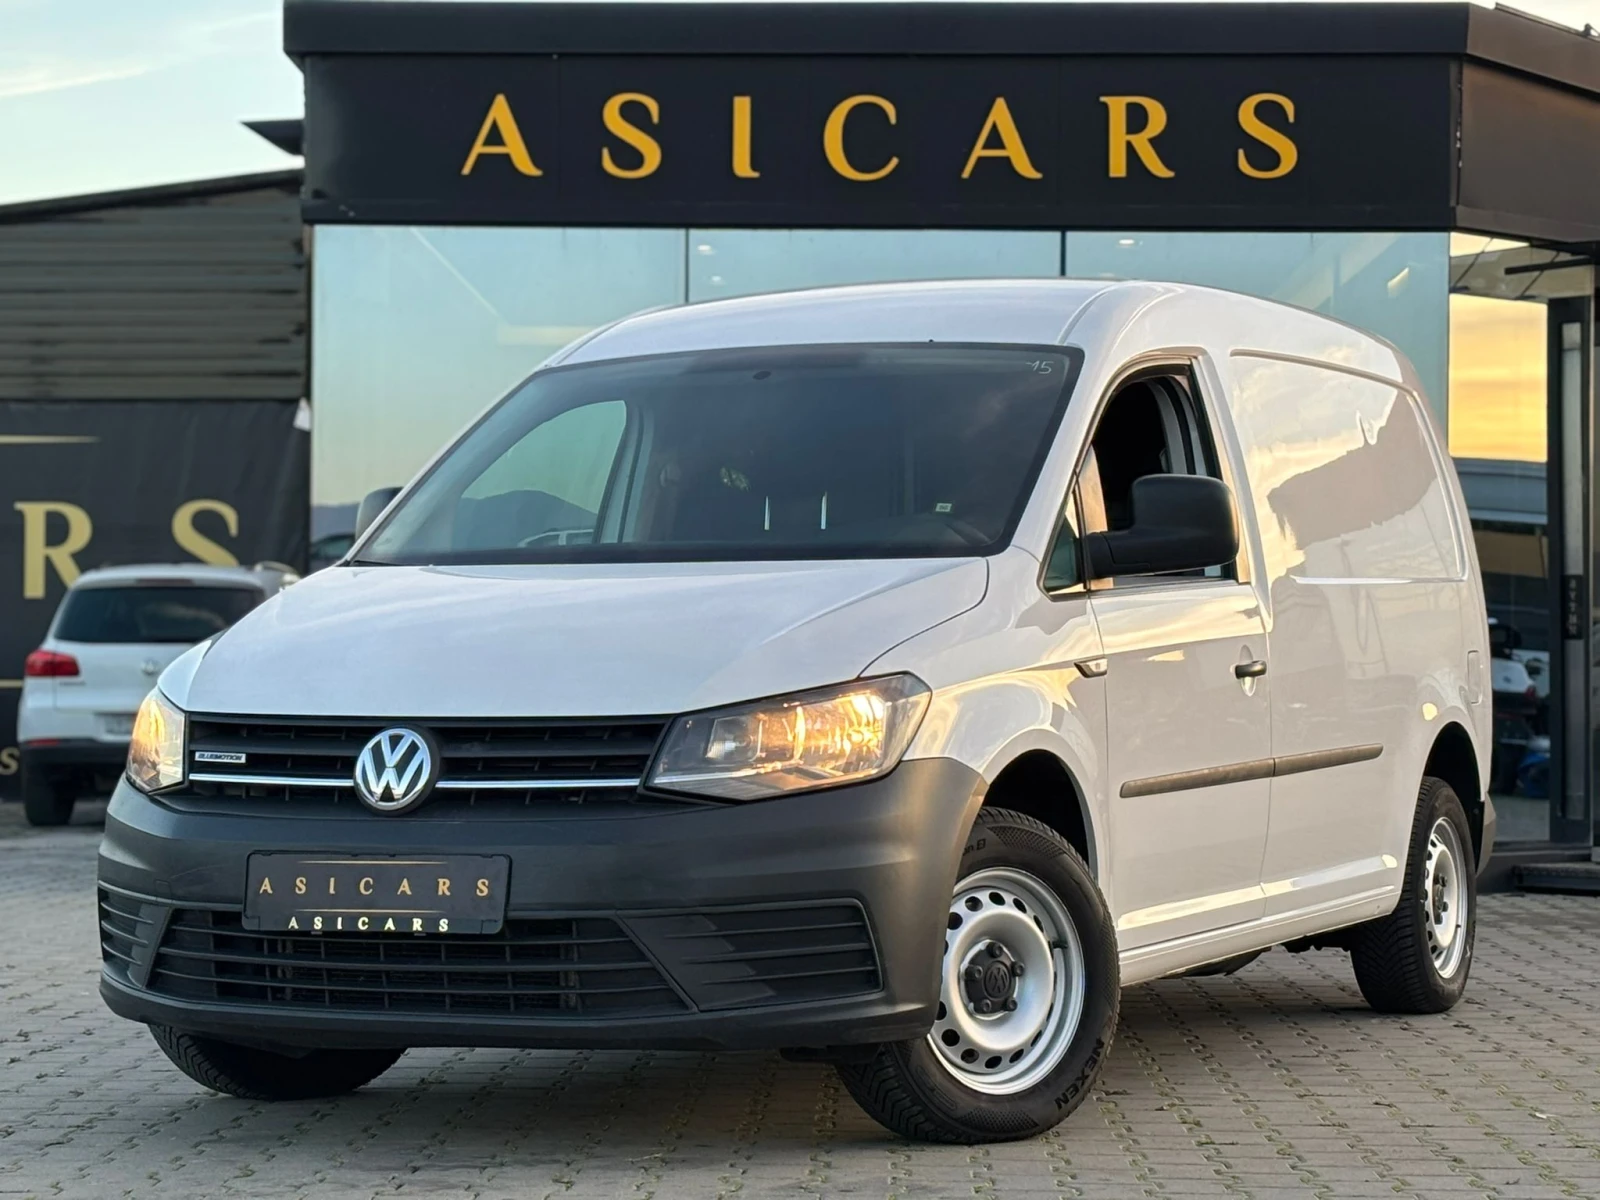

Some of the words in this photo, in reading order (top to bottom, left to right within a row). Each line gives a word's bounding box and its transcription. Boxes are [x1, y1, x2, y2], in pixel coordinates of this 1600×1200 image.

[460, 92, 1299, 181] ASICARS
[259, 877, 490, 897] ASICARS
[288, 916, 450, 932] ASICARS
[1054, 1036, 1105, 1110] NEXEN
